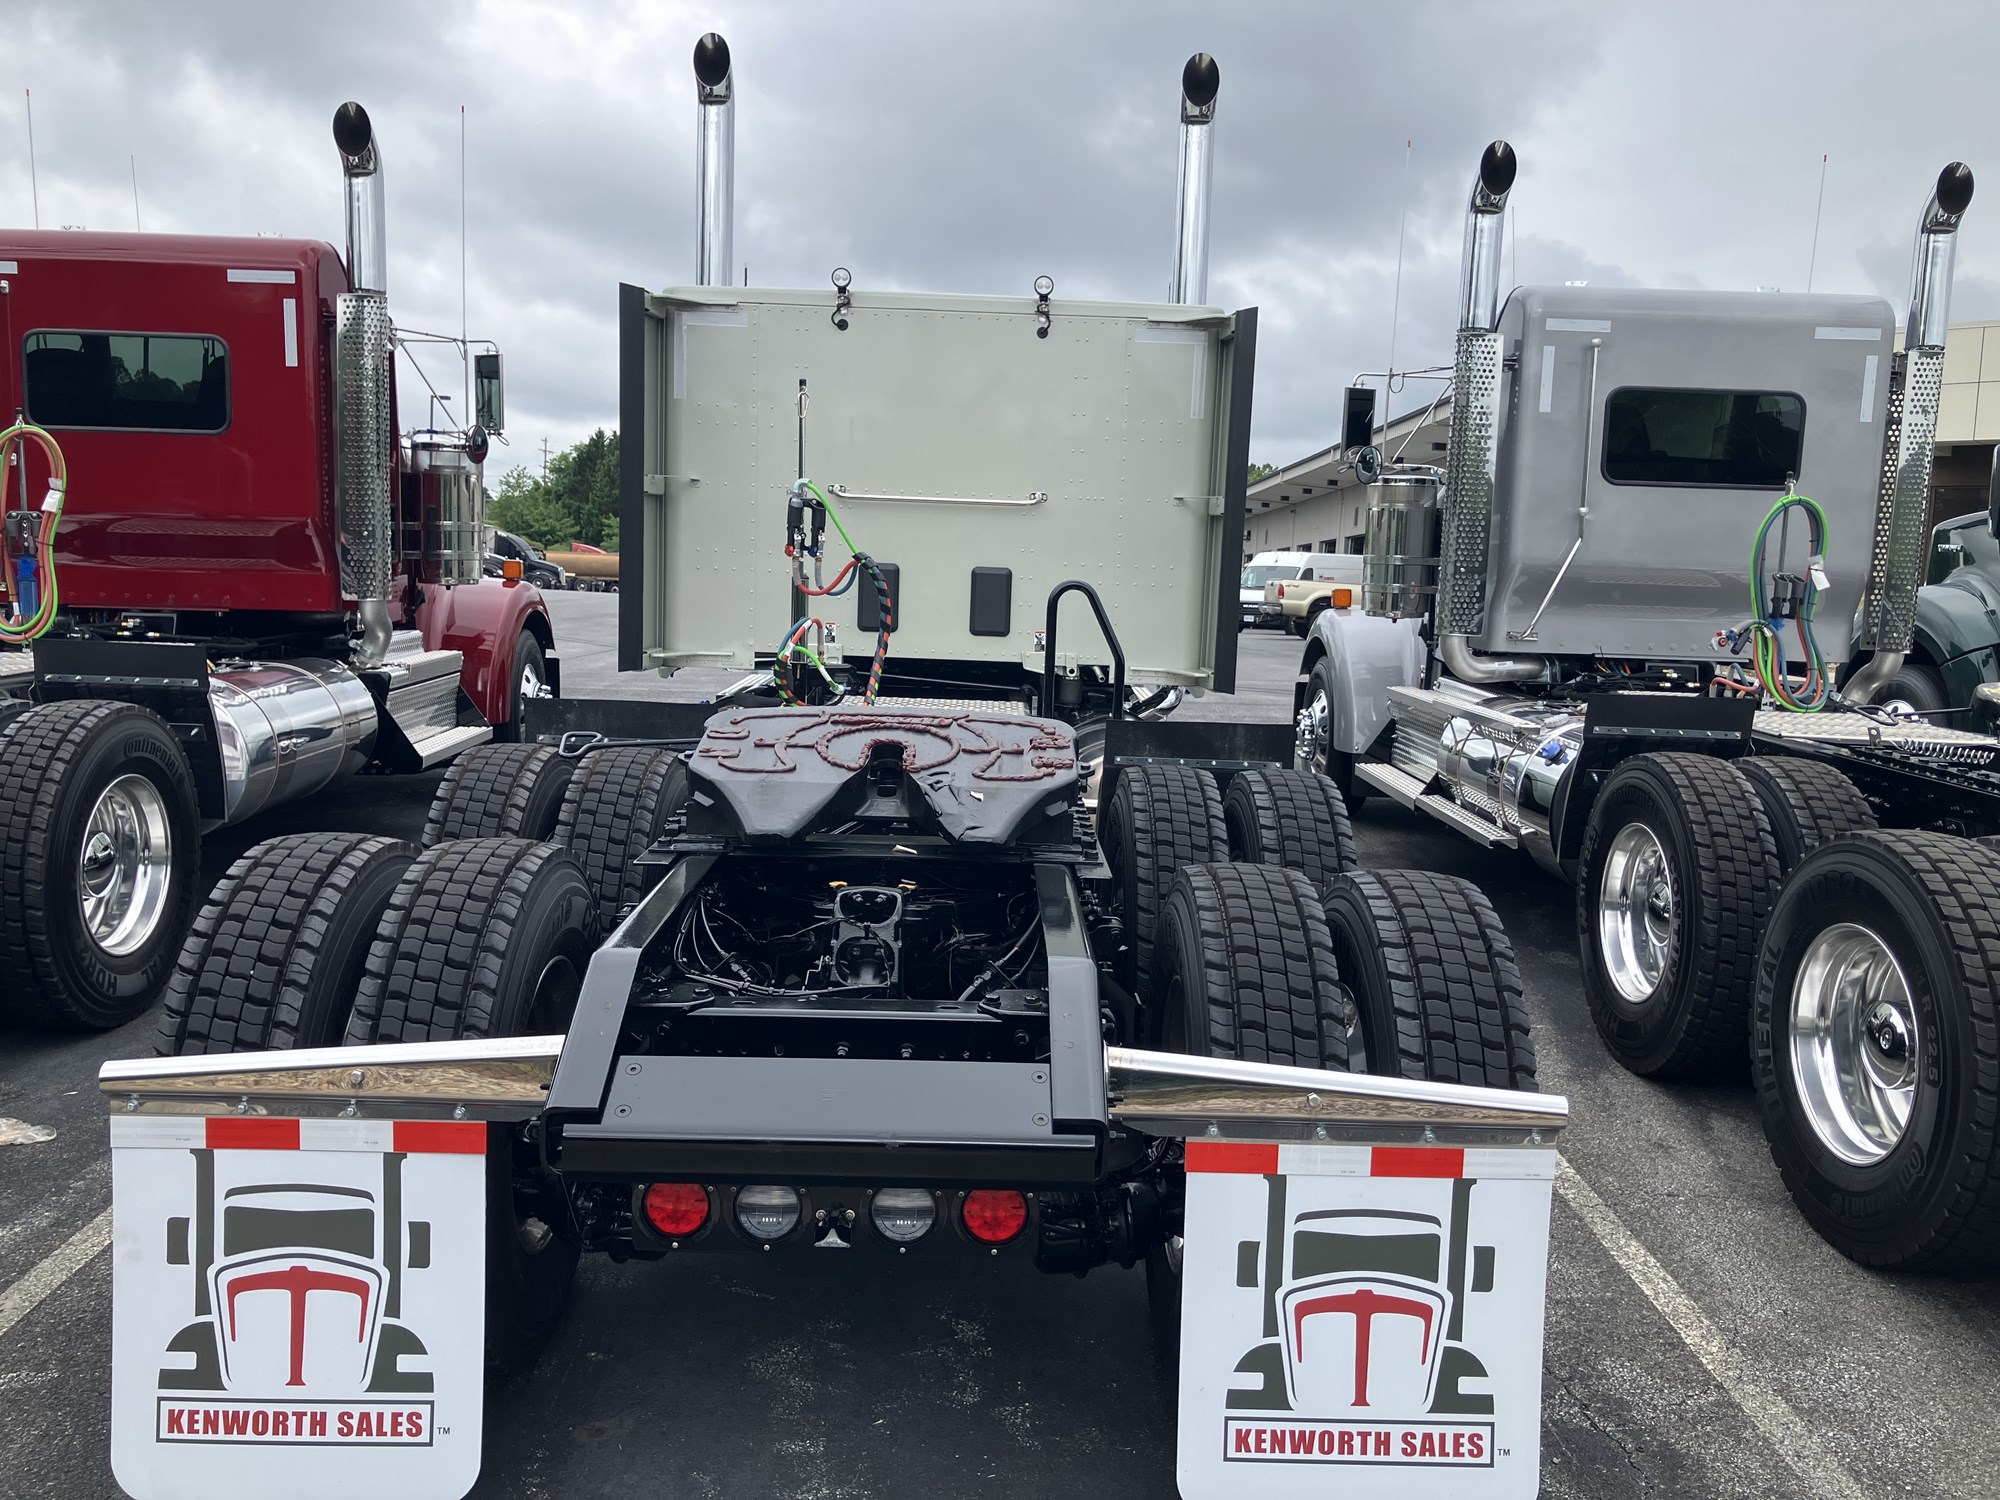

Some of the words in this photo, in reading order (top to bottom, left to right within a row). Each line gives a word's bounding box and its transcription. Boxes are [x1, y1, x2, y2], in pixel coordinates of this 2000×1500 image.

[1922, 994, 1933, 1013] R
[1754, 943, 1784, 1112] TINENTAL
[1926, 1025, 1939, 1082] 22.5
[167, 1409, 327, 1437] KENWORTH
[337, 1411, 423, 1437] SALES
[1234, 1428, 1391, 1456] KENWORTH
[1401, 1431, 1484, 1458] SALES
